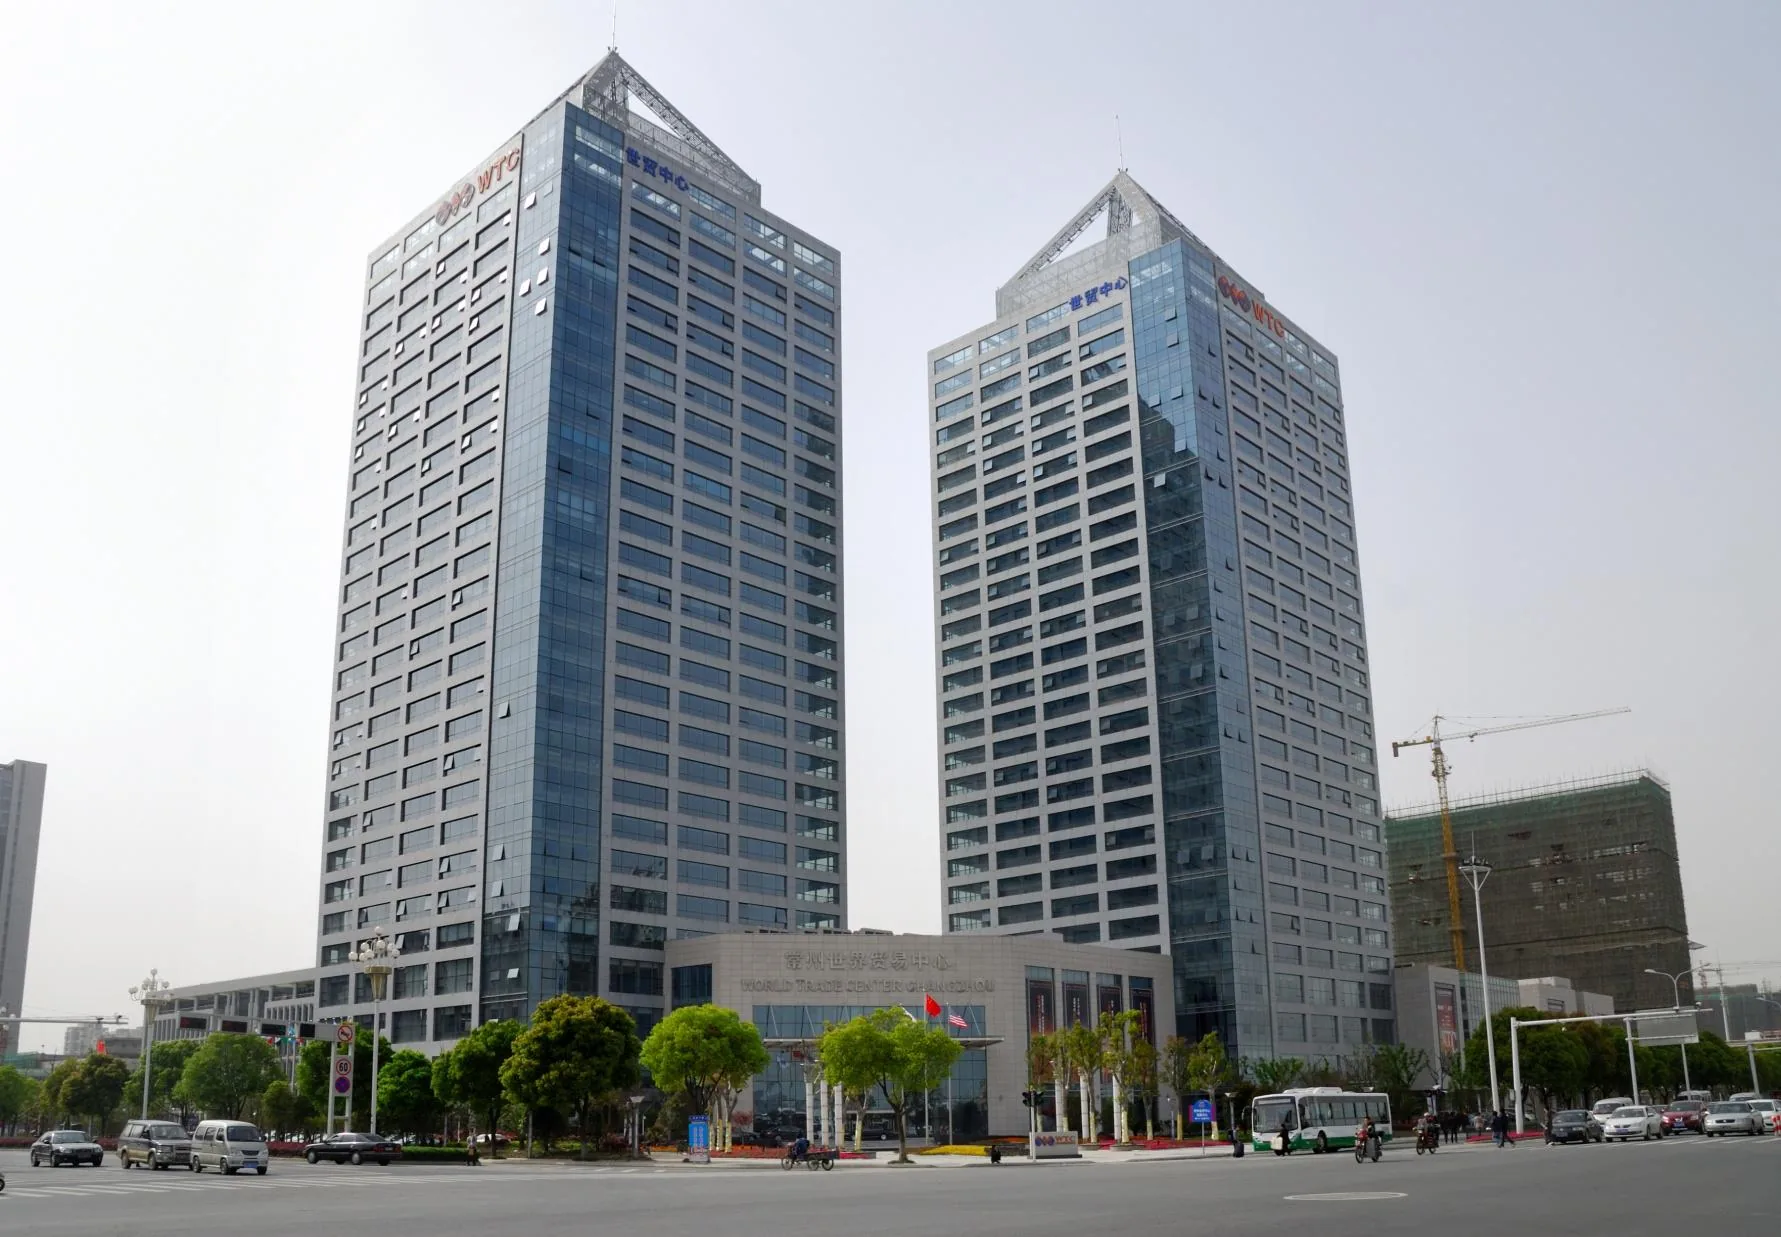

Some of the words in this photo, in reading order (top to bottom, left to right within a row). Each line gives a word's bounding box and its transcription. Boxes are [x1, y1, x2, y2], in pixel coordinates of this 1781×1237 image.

[477, 148, 520, 193] WTC
[625, 146, 689, 192] 世贸中心
[1069, 276, 1129, 311] 世贸中心
[1252, 299, 1285, 338] WTC
[785, 951, 950, 971] 常州世界贸易中心
[741, 979, 792, 993] WORLD
[796, 979, 843, 993] TRADE
[846, 979, 902, 993] CENTER
[906, 979, 995, 993] CHANGZHOU
[339, 1062, 349, 1072] 60
